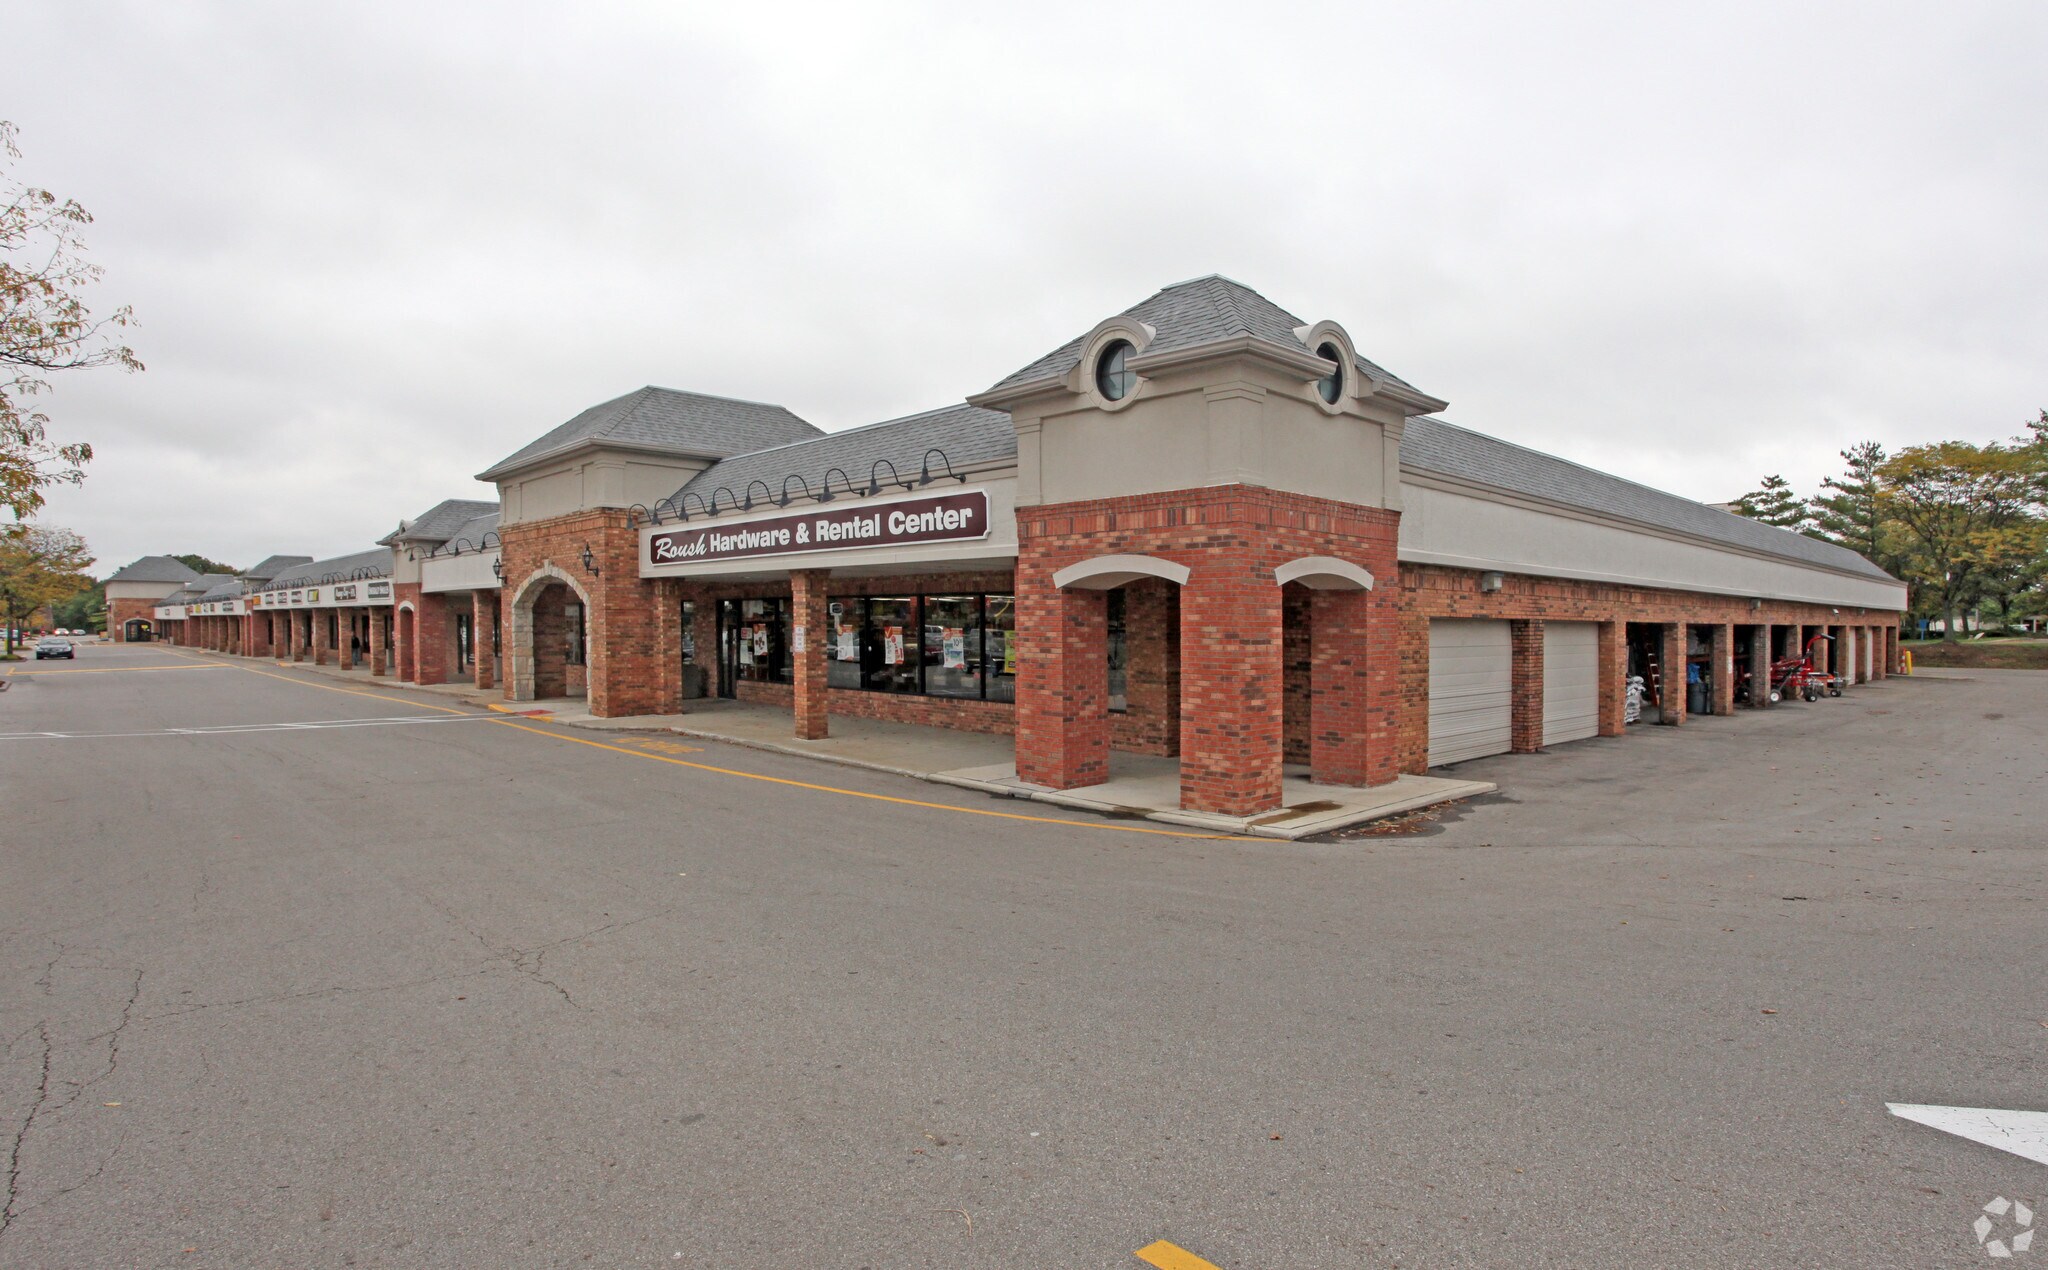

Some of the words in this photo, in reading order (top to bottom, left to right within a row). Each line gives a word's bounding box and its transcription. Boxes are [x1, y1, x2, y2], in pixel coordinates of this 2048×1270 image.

[655, 532, 708, 560] Roush
[709, 529, 791, 553] Hardware
[796, 522, 812, 545] &
[815, 513, 881, 542] Rental
[887, 505, 973, 536] Center
